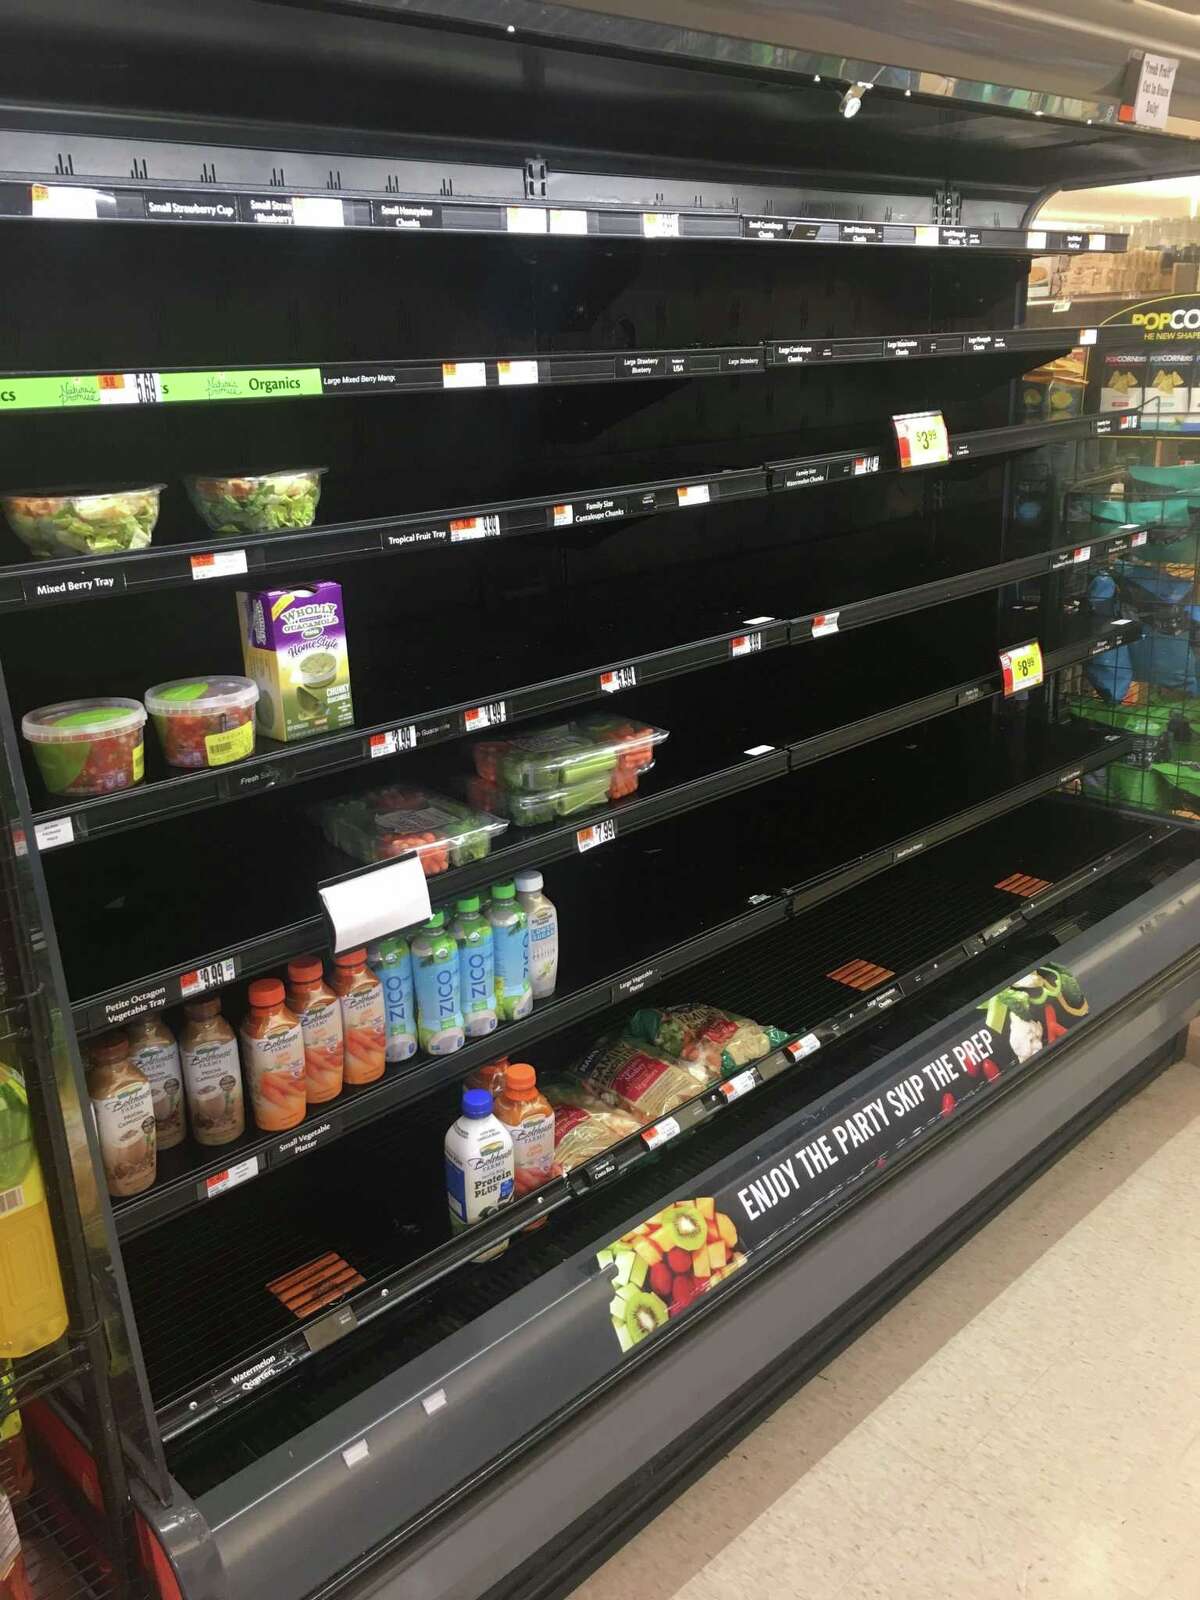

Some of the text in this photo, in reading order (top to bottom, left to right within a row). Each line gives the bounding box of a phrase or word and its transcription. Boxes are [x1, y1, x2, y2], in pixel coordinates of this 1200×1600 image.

[149, 202, 234, 217] Small Strawberry Cup
[1156, 332, 1174, 340] NEW
[249, 376, 300, 393] Organics
[323, 376, 341, 386] Large
[342, 375, 360, 384] Mixed
[361, 375, 377, 384] Berry
[605, 509, 624, 518] Chunks
[389, 530, 446, 545] Tropical Fruit Tray
[37, 577, 114, 595] Mixed Berry Tray
[282, 604, 337, 623] WHOLLY
[469, 954, 487, 1000] ZICO
[105, 986, 166, 1013] Petite Octagon
[386, 976, 406, 1022] ZICO
[437, 970, 455, 1016] ZICO
[108, 997, 167, 1024] Vegetable Tray
[737, 1029, 994, 1221] ENJOY THE PARTY SKIP THE PREP
[280, 1123, 331, 1152] Small Vegetable
[294, 1140, 318, 1153] Platter
[474, 1170, 512, 1190] Protein
[474, 1183, 498, 1198] PLUS
[230, 1355, 276, 1384] Watermelon
[242, 1368, 276, 1391] Quarters
